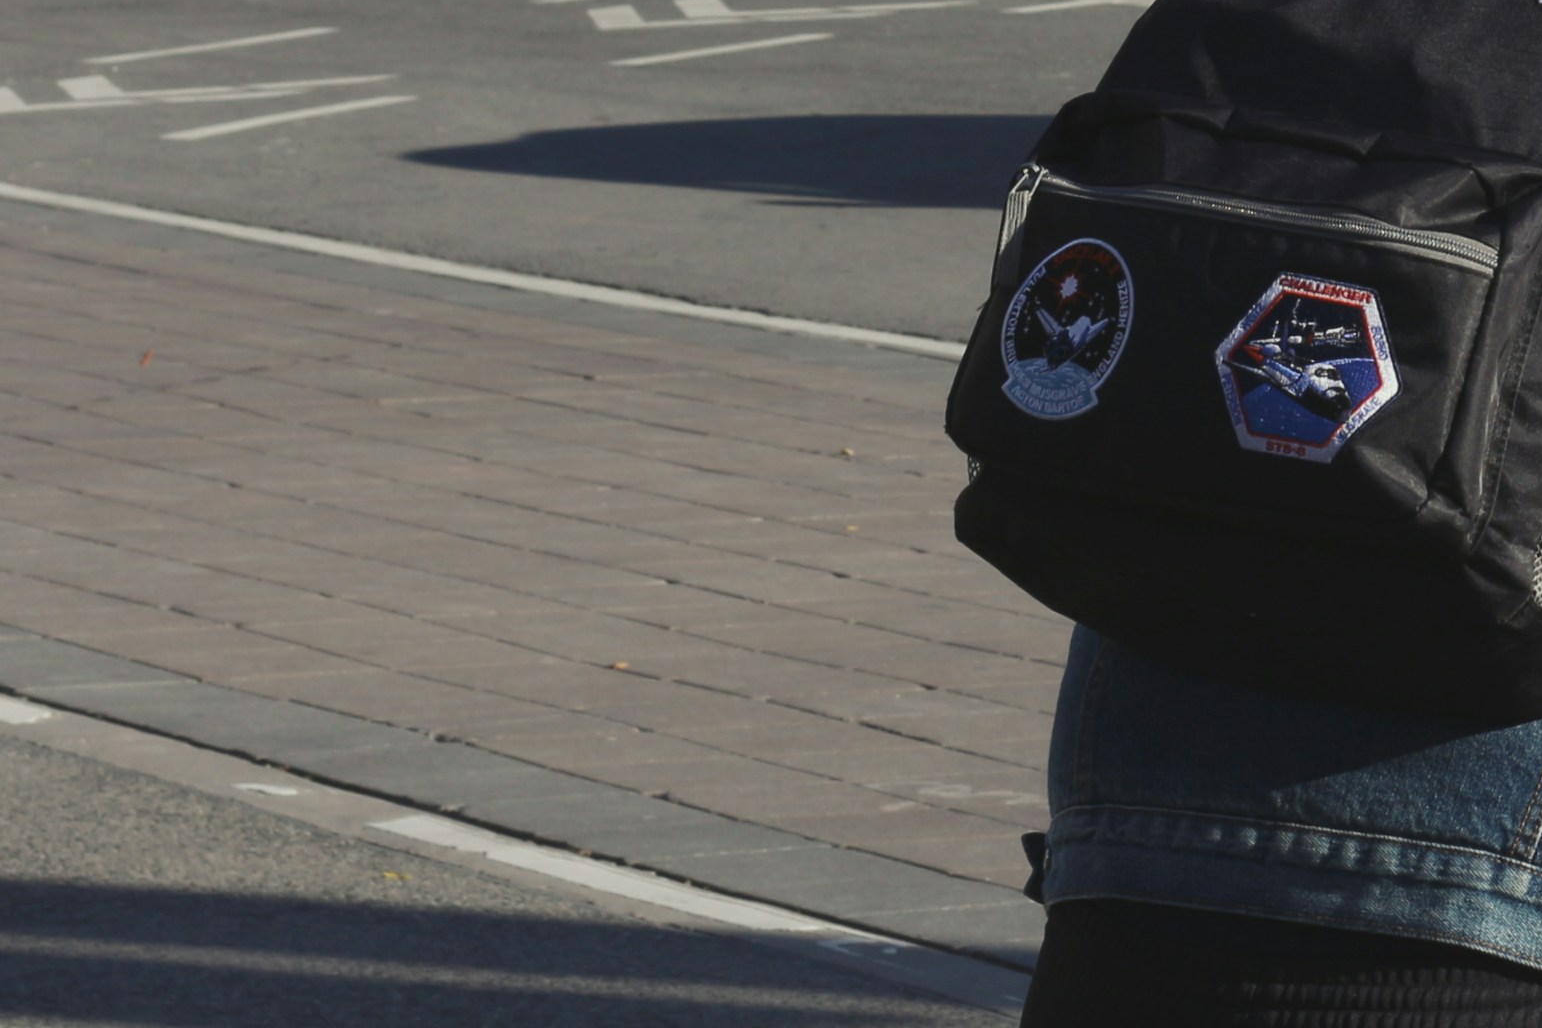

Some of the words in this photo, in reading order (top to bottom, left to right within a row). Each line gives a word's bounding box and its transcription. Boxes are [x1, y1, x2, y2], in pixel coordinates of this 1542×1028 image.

[1279, 277, 1373, 304] CHALLENGER
[1007, 266, 1047, 339] FULLERTON
[1029, 381, 1087, 401] MUSGRAVE
[1087, 331, 1123, 386] ENGLAND
[1116, 278, 1128, 328] HENIZE
[1011, 385, 1043, 412] ACTON
